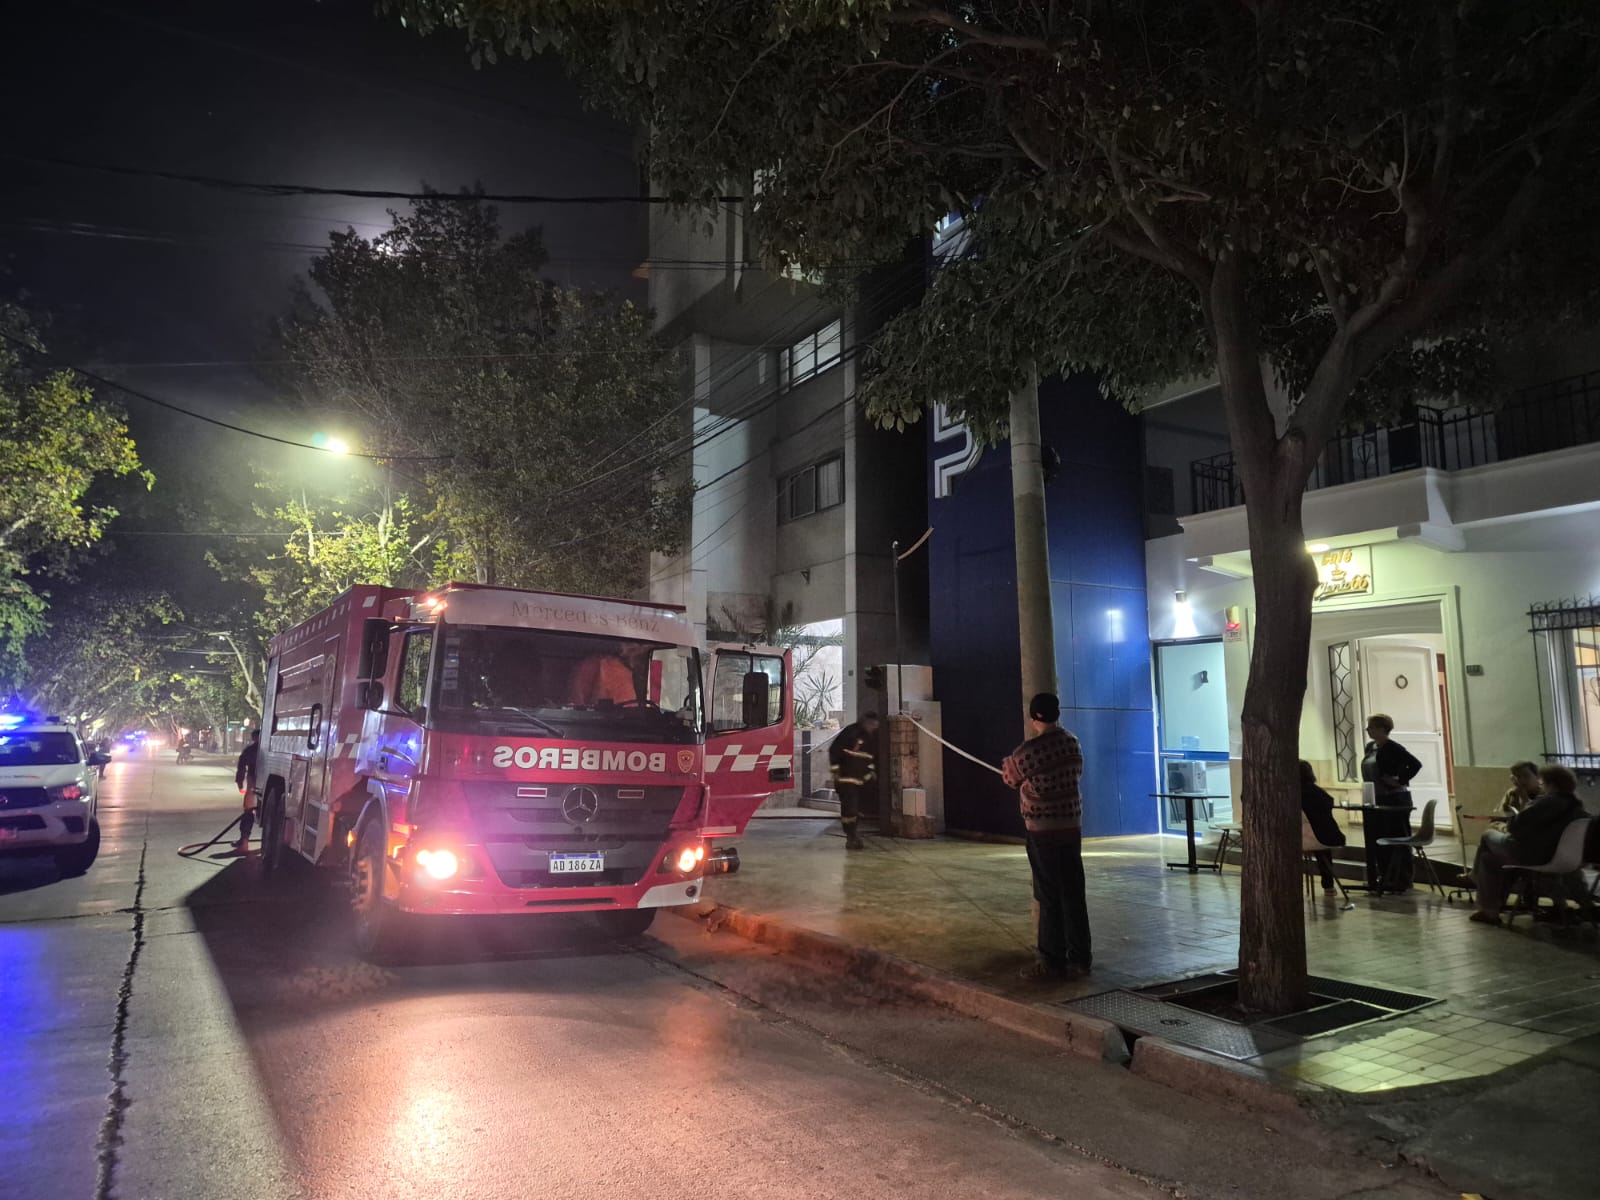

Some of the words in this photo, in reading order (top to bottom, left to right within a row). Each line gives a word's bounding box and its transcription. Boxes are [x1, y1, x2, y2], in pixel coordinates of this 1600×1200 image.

[1321, 549, 1353, 566] Café
[553, 860, 565, 871] AD
[568, 860, 587, 871] 186
[589, 859, 601, 870] ZA
